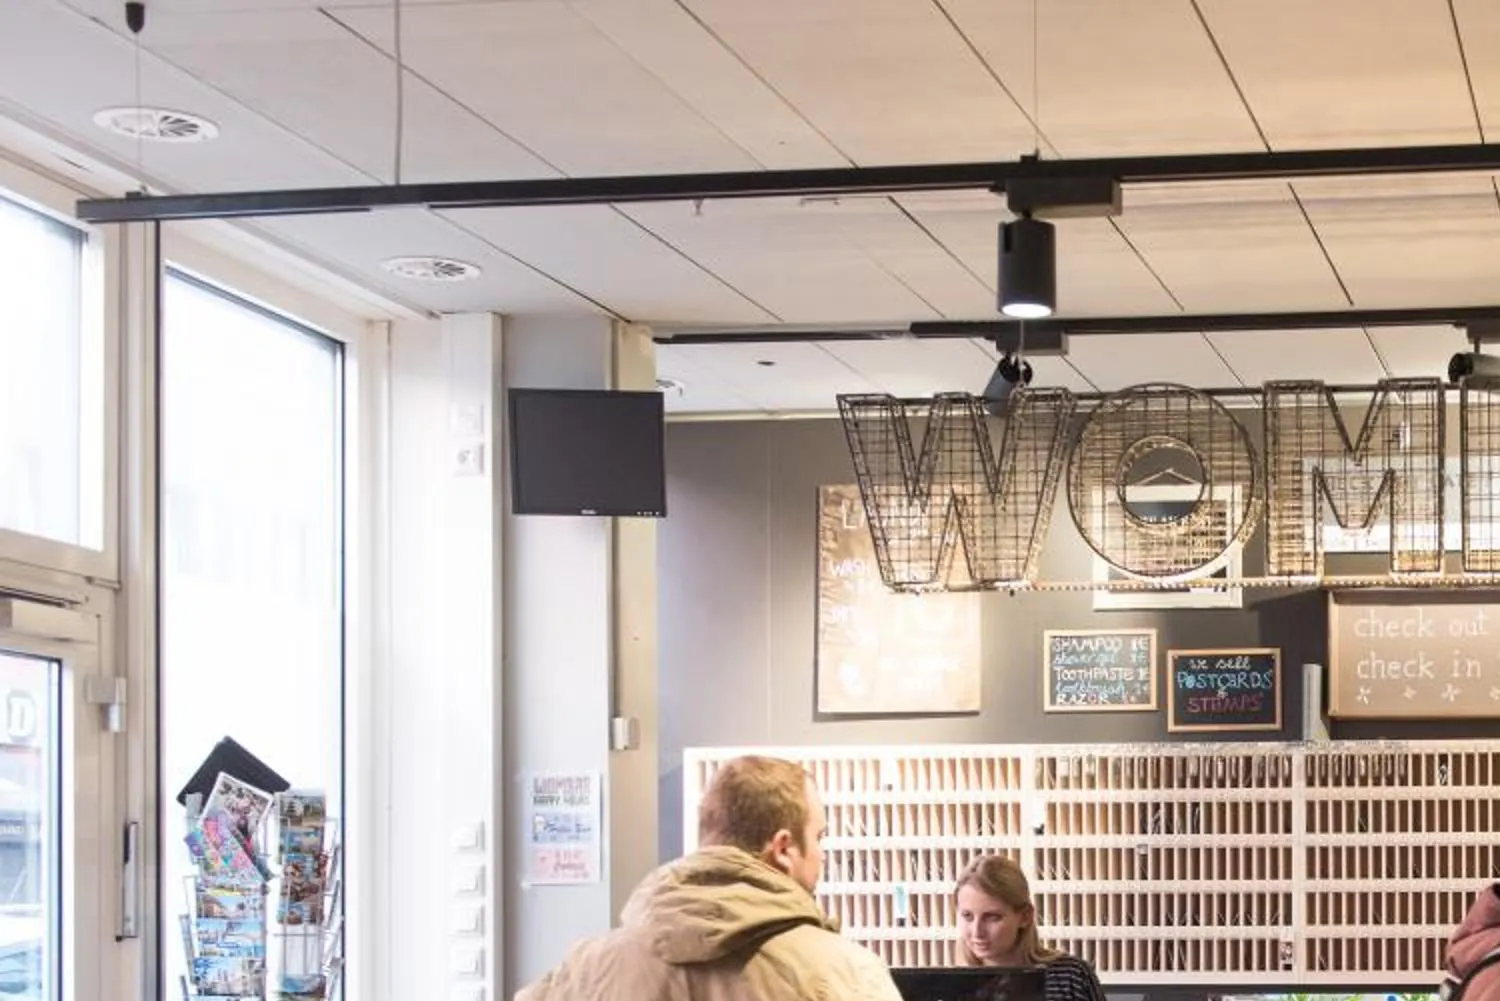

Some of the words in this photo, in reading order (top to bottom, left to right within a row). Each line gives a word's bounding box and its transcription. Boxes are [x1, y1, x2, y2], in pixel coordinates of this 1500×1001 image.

[1353, 608, 1436, 638] check
[1448, 611, 1490, 638] out
[1215, 655, 1252, 671] sell
[1356, 649, 1436, 681] check
[1450, 649, 1483, 679] in
